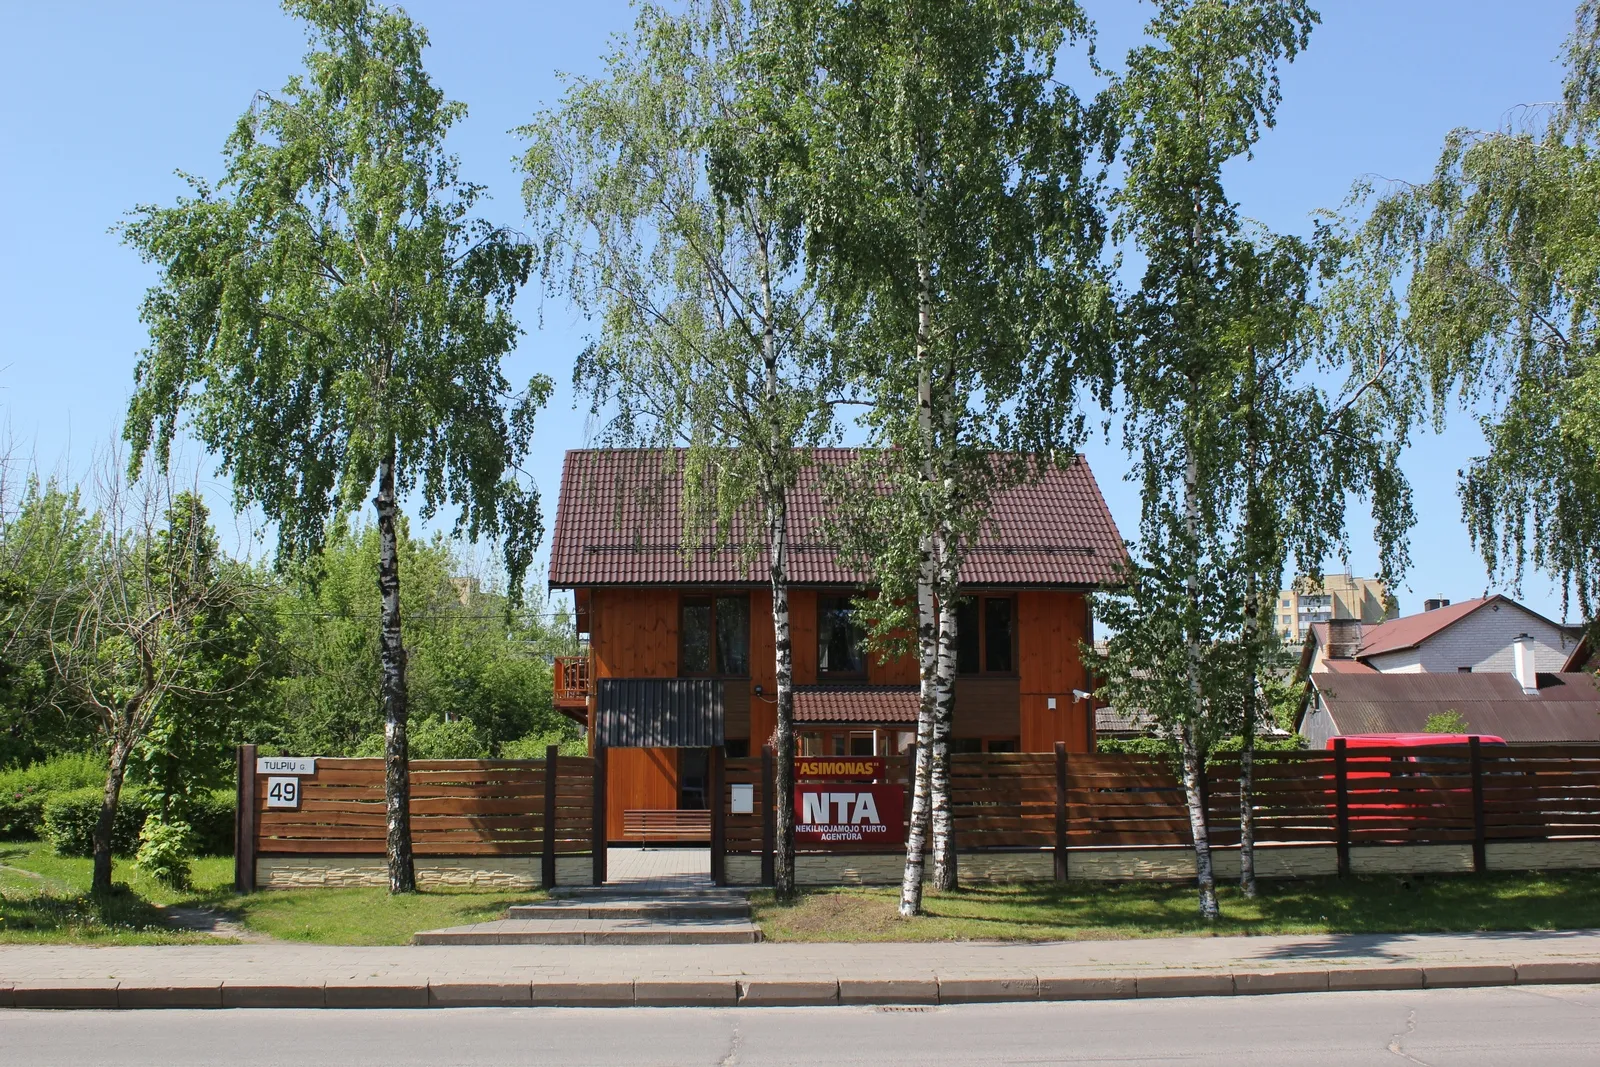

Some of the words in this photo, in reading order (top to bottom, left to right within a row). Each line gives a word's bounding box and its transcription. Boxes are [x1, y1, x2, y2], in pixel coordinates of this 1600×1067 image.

[264, 761, 296, 771] TULPIŲ
[270, 782, 296, 802] 49
[802, 792, 881, 824] NTA
[795, 825, 860, 833] NEKILNOJAMOJO
[861, 825, 887, 833] TURTO
[820, 832, 862, 841] AGENTŪRA
